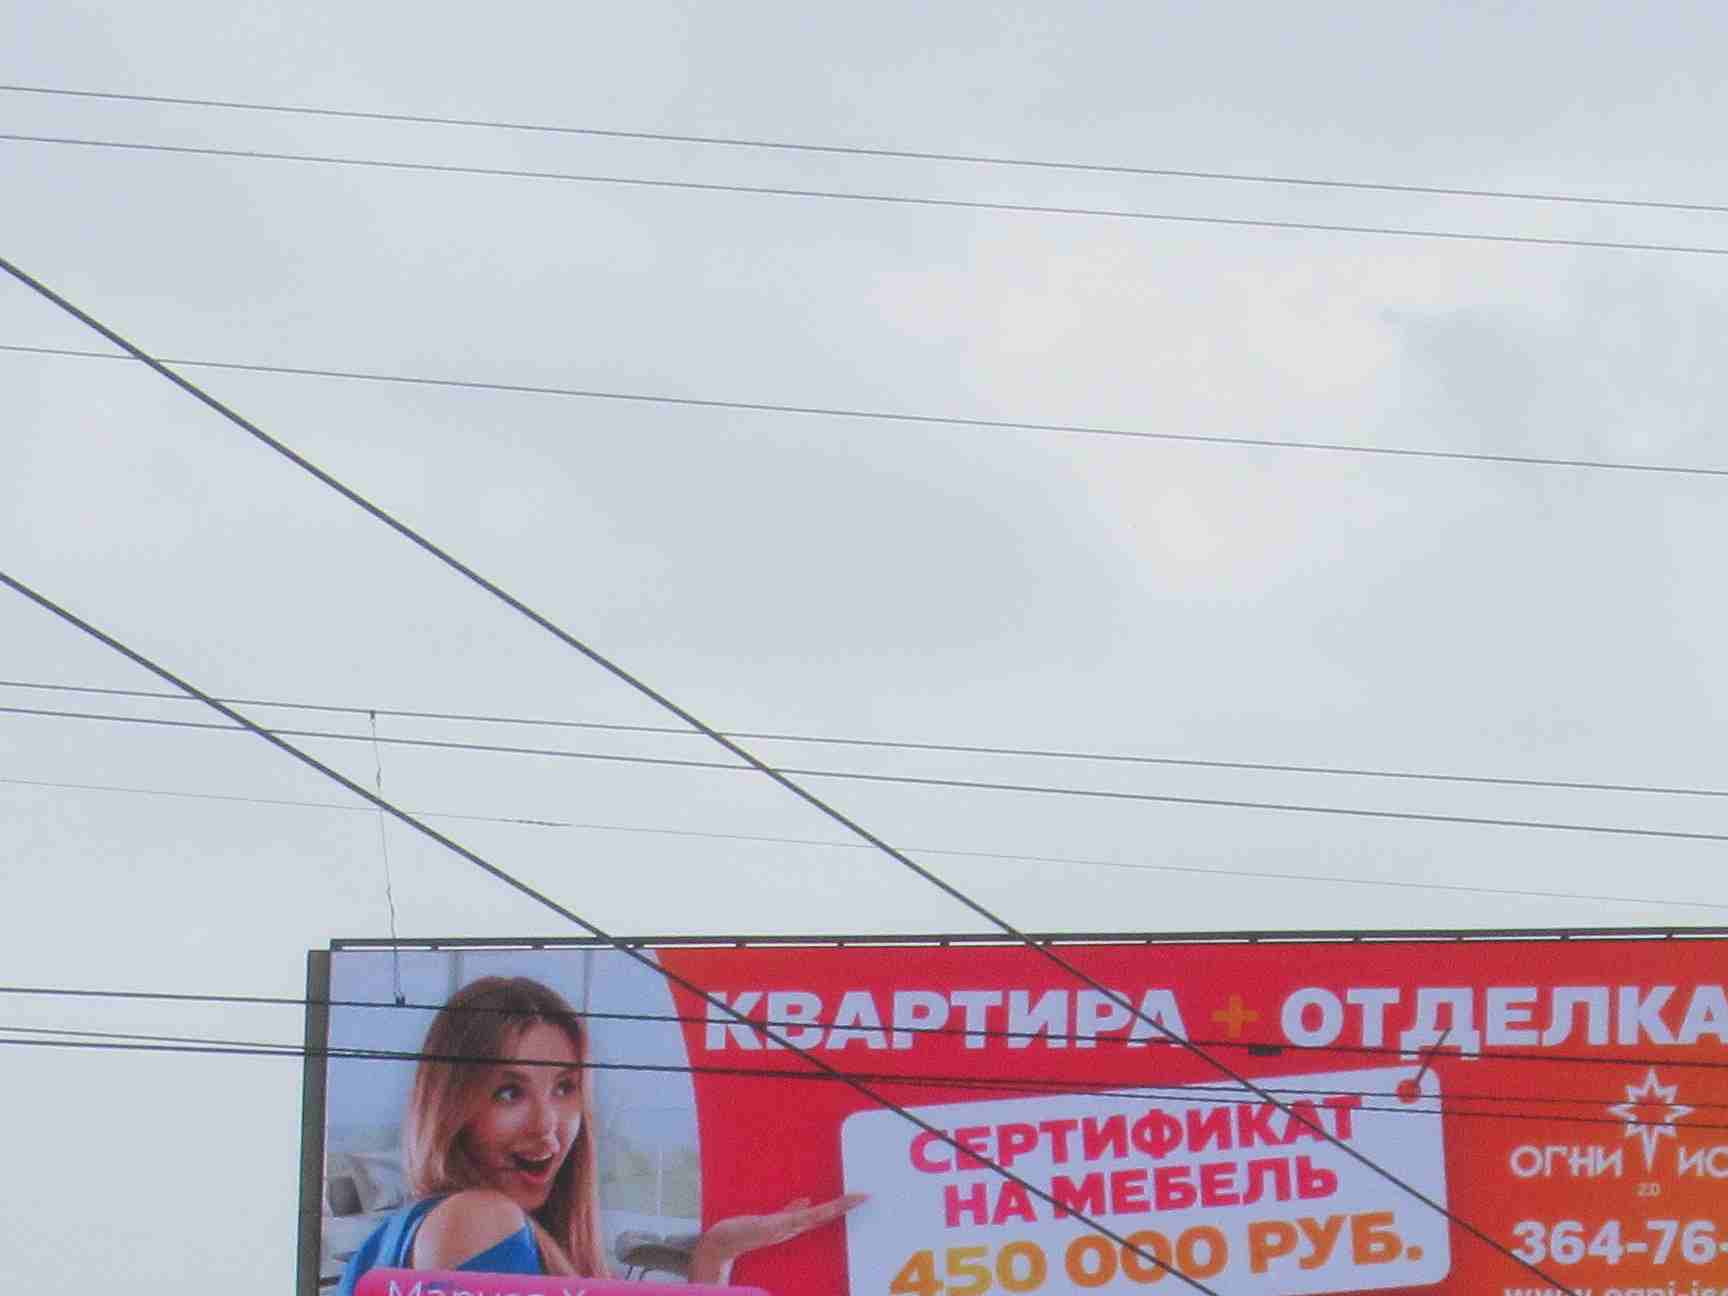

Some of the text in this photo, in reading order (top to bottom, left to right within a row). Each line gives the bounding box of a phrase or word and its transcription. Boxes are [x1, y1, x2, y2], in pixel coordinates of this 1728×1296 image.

[704, 990, 1190, 1051] КВАРТИРА
[908, 1095, 1363, 1174] СЕРТИФИКАТ
[1509, 1145, 1623, 1179] ОГНИ
[944, 1155, 1339, 1228] НА МЕБЕЛЬ
[1064, 1224, 1230, 1289] 000
[1248, 1211, 1424, 1274] РУБ.
